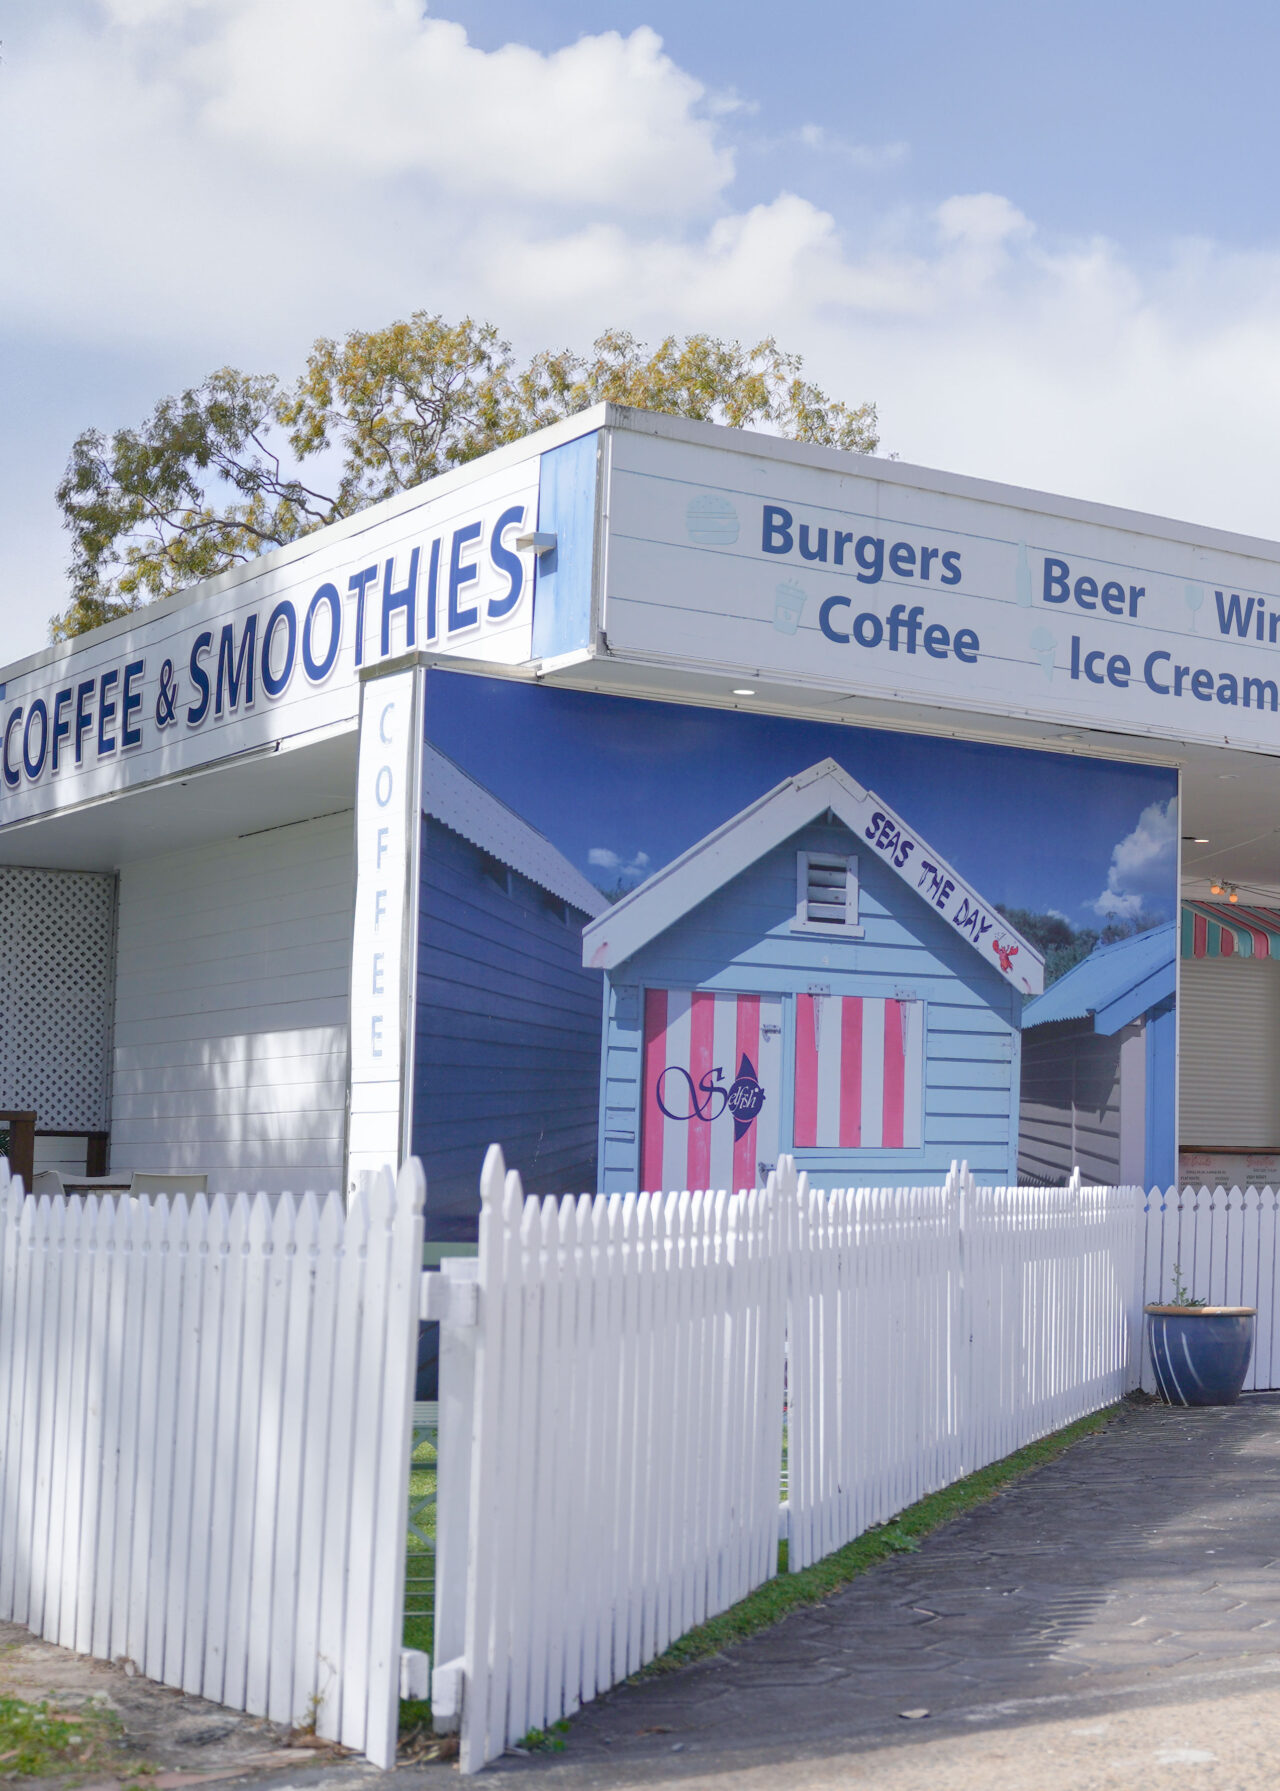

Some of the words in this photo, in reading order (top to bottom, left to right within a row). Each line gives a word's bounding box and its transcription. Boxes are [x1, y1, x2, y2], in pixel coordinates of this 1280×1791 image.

[761, 504, 962, 585] Burgers
[1042, 556, 1146, 618] Beer
[3, 658, 144, 787] COFFEE
[155, 658, 177, 727] &
[187, 505, 526, 726] SMOOTHIES
[818, 595, 980, 664] Coffee
[1070, 634, 1131, 689] Ice
[1143, 650, 1279, 712] Cream
[370, 701, 396, 1058] COFFEE
[865, 812, 915, 868] SEAS
[918, 860, 955, 909] THE
[952, 897, 993, 943] DAY
